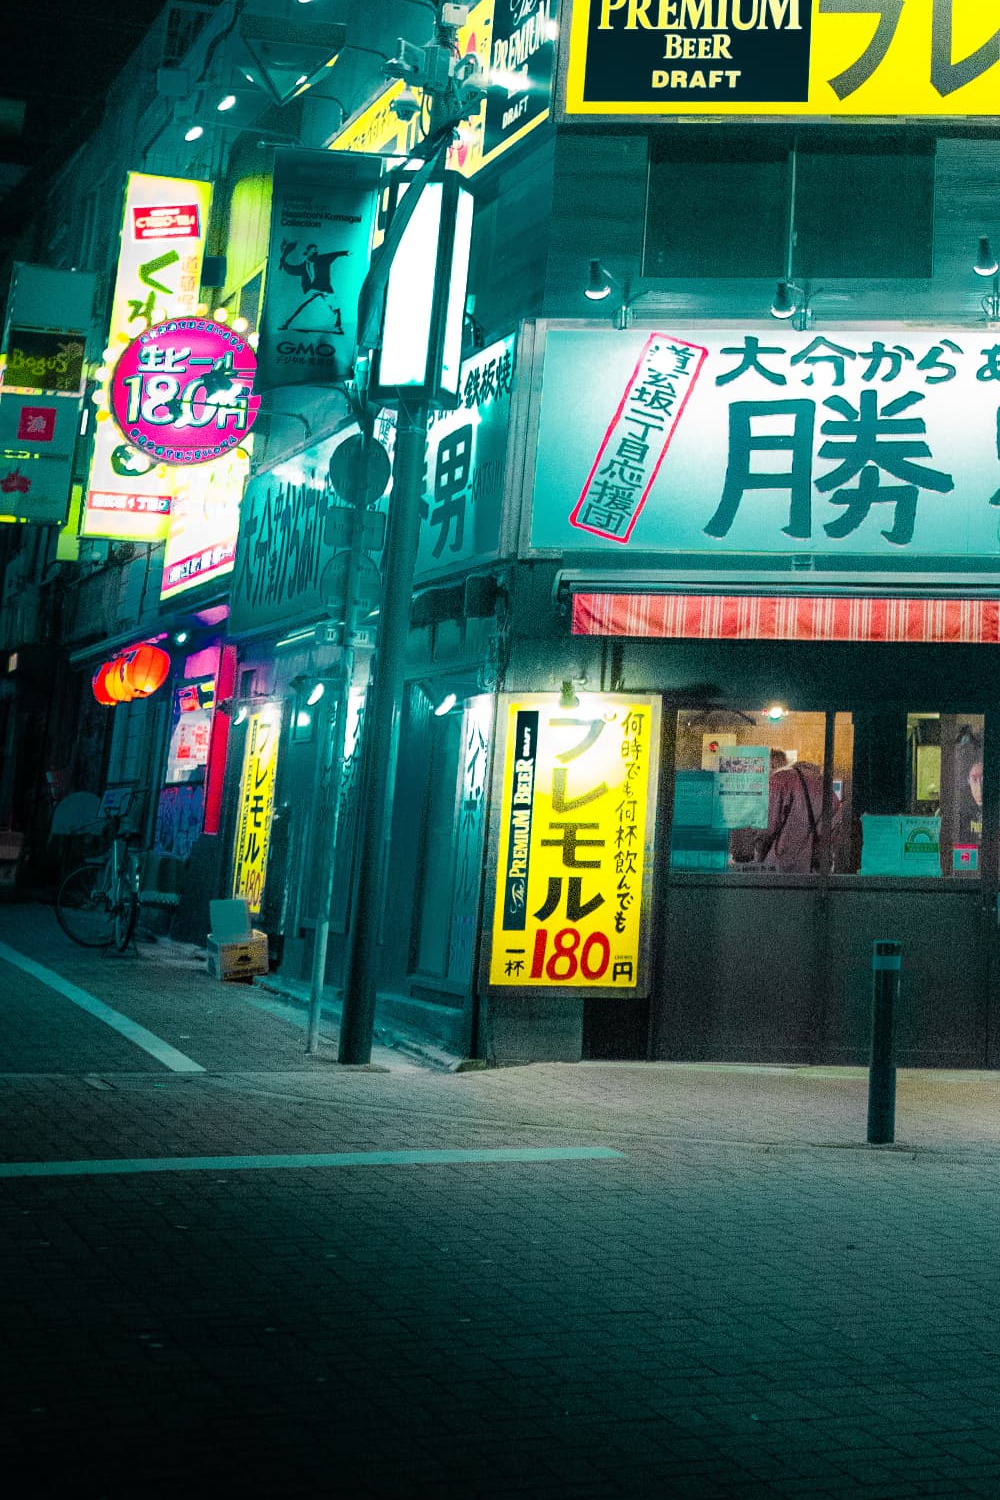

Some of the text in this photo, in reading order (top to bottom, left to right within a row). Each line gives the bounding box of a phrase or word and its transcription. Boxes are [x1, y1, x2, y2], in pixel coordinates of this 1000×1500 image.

[662, 34, 733, 60] BEER
[651, 71, 742, 89] DRAFT
[276, 341, 337, 357] GMO
[514, 757, 534, 806] BEER
[533, 712, 616, 922] プレモル
[613, 712, 644, 934] 何時でも何杯飲んでも
[509, 809, 530, 879] PREMIUM
